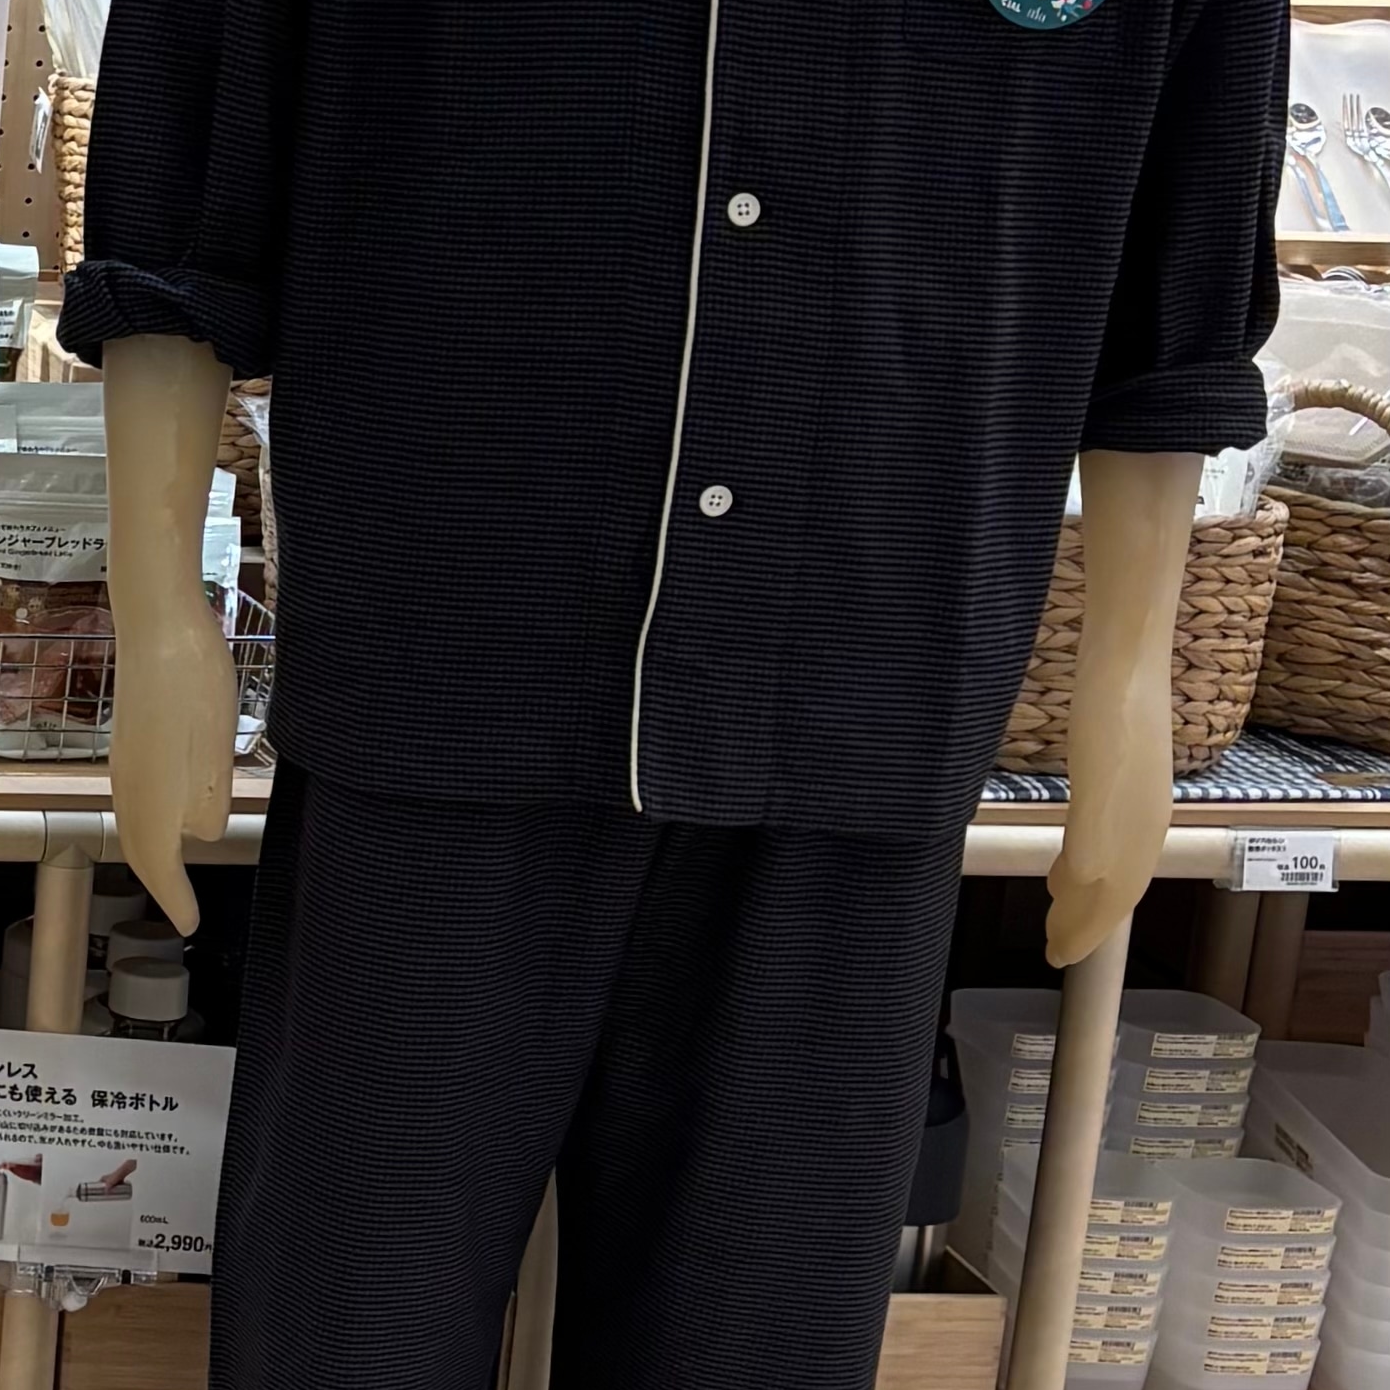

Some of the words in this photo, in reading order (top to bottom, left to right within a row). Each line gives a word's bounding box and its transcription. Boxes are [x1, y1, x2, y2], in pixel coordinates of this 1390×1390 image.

[90, 1090, 179, 1112] 保冷ボトル
